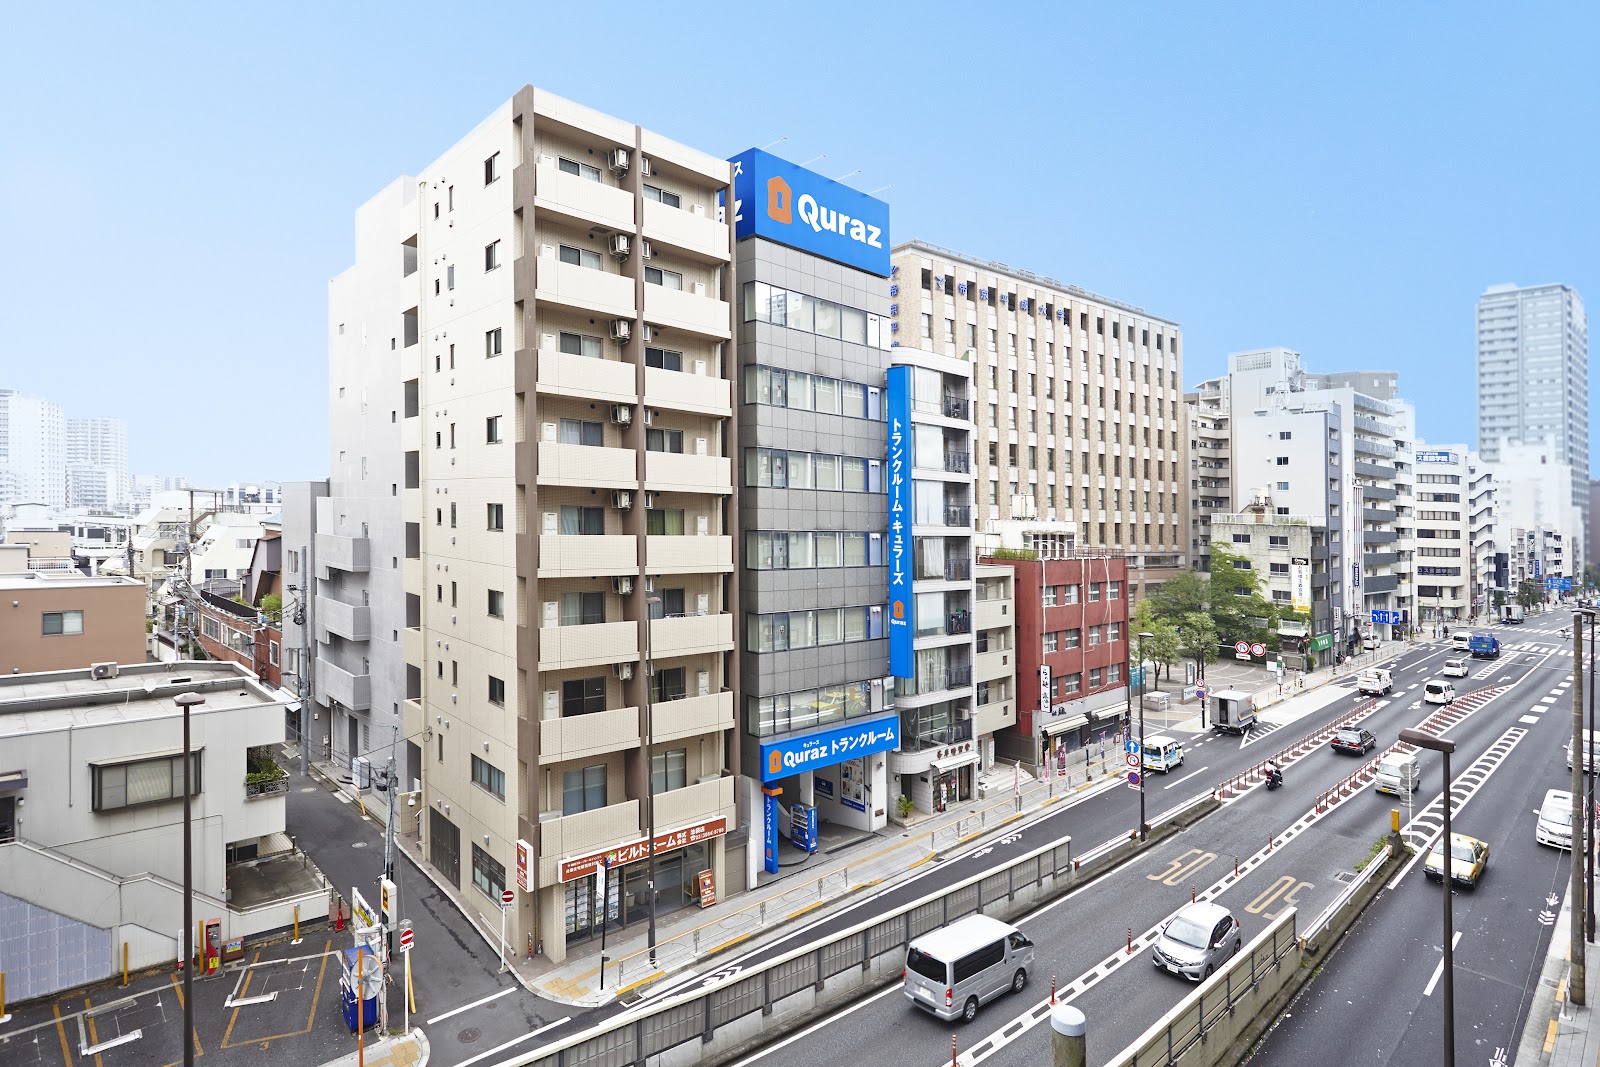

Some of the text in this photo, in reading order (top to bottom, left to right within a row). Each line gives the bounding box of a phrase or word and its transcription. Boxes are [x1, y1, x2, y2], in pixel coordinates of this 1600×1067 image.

[797, 193, 882, 249] Quraz
[958, 282, 1065, 320] 帝京平成大学
[891, 418, 904, 586] トランクルーム・キュラーズ
[890, 618, 907, 626] Quraz
[783, 727, 895, 768] Quraz トランクルーム
[803, 739, 820, 749] キュラーズ
[1145, 848, 1219, 887] 50
